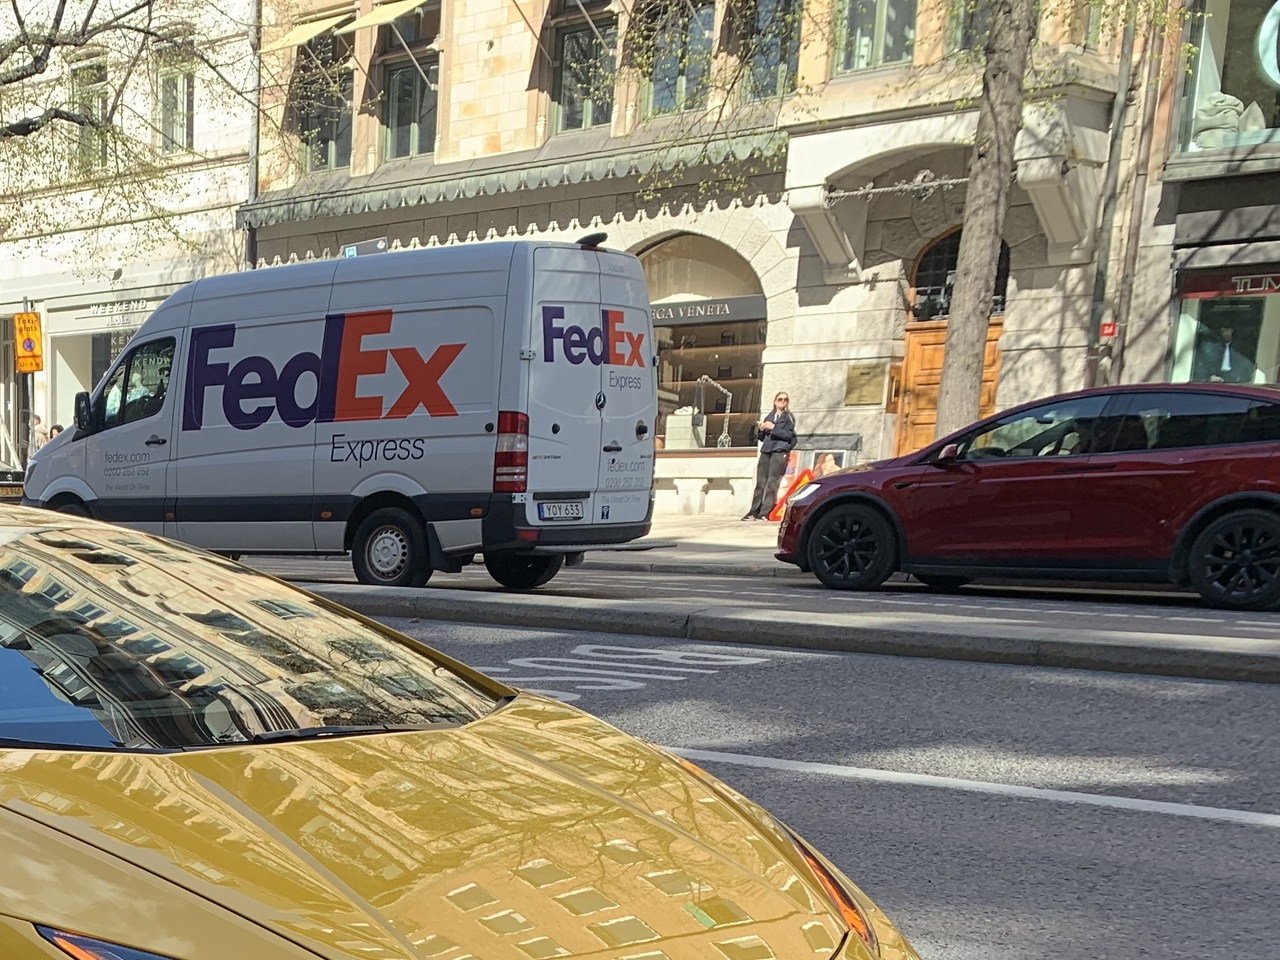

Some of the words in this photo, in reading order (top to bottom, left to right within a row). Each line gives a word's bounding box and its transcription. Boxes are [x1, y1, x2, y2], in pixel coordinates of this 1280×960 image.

[90, 299, 147, 314] WEEKEND
[651, 307, 674, 320] EGA
[678, 303, 730, 318] VENETA
[541, 305, 646, 368] FedEx
[182, 308, 468, 431] FedEx
[609, 371, 642, 392] Express
[104, 451, 151, 463] fedex.com
[330, 434, 425, 468] Express
[607, 458, 646, 472] fedex.com
[546, 503, 564, 516] YOY
[565, 503, 580, 516] 633
